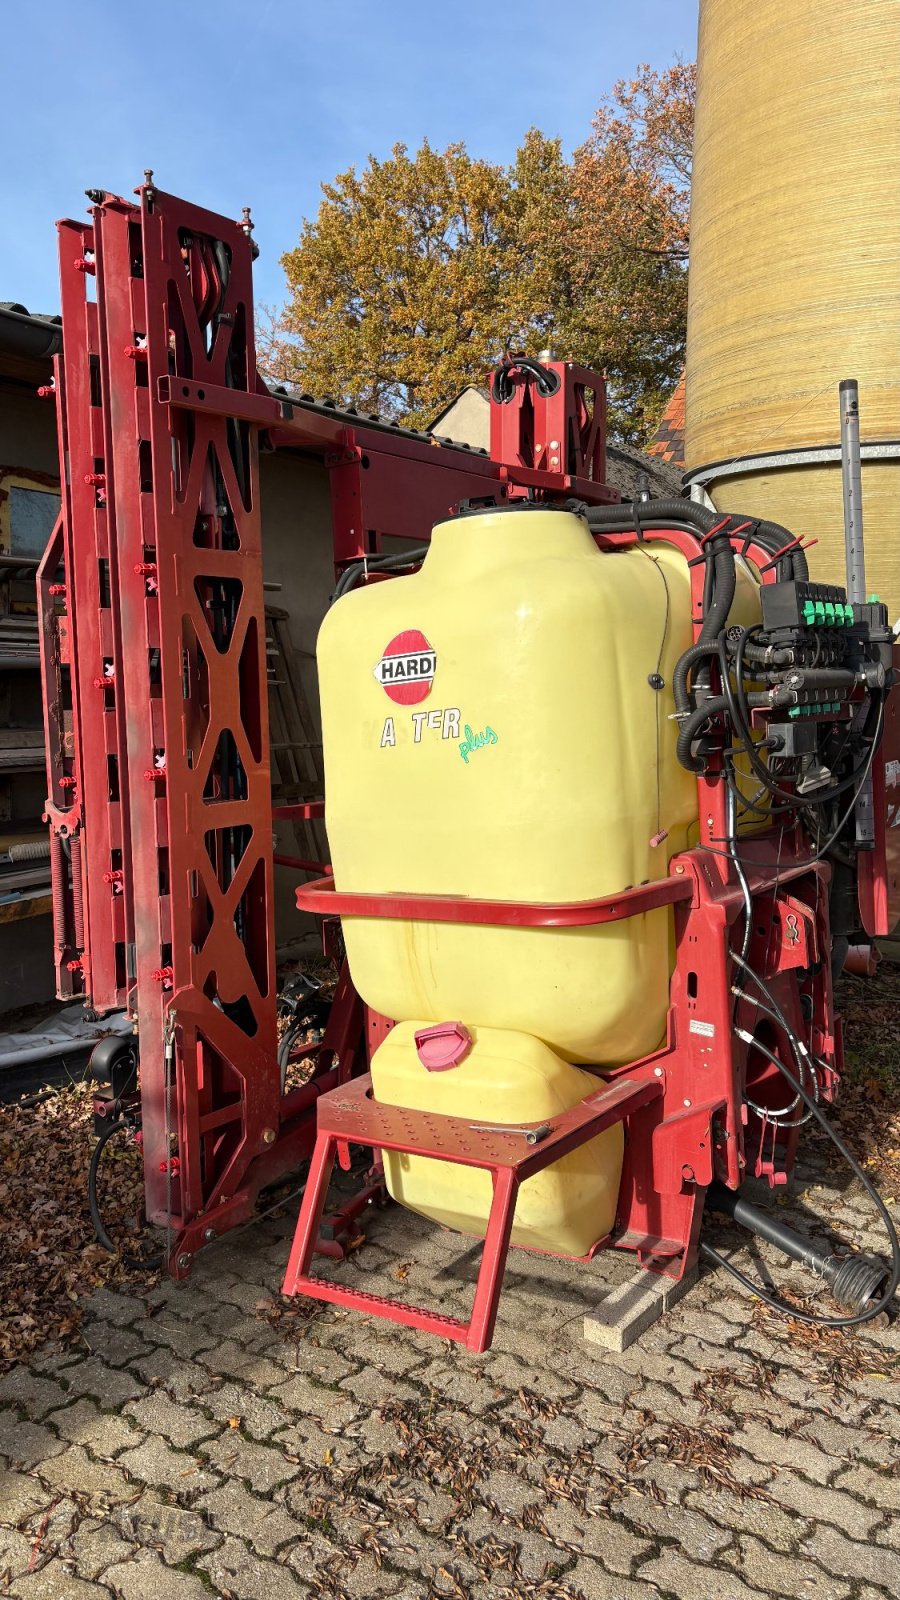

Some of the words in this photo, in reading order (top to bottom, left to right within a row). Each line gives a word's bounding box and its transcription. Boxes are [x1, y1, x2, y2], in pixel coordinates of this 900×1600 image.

[850, 520, 854, 528] 3
[381, 656, 437, 680] HARDI
[459, 724, 498, 763] plus
